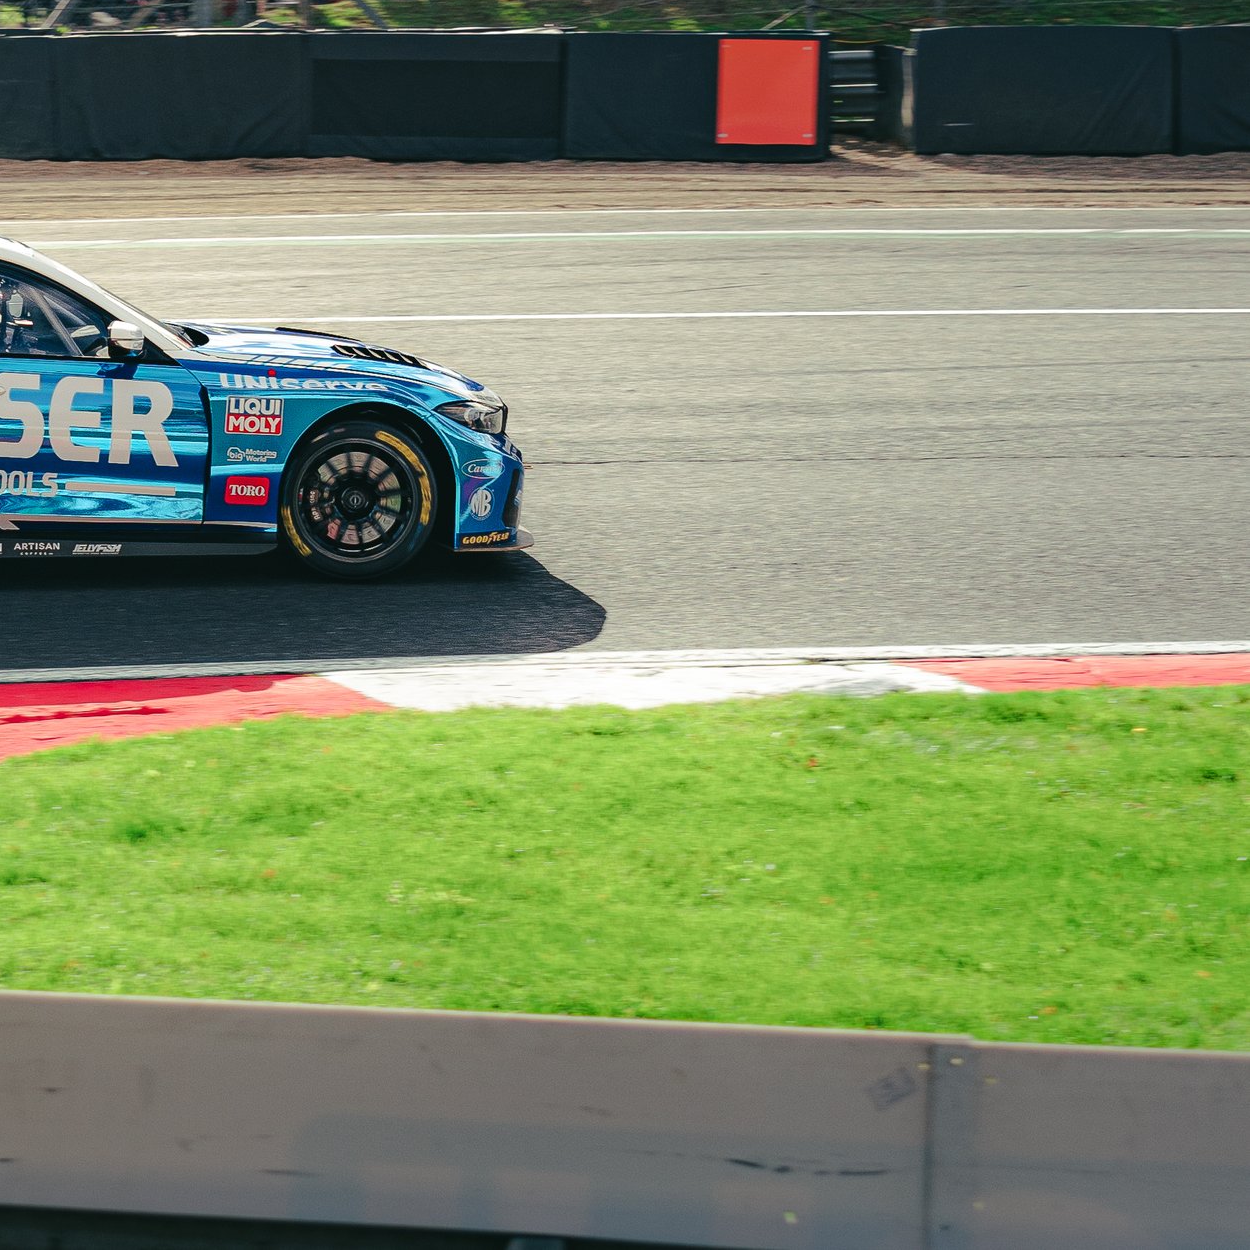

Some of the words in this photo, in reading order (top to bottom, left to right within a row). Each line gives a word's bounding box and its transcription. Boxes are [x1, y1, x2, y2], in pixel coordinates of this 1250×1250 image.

[229, 397, 281, 416] LIQUI
[228, 415, 280, 433] MOLY
[245, 448, 277, 458] Motoring
[229, 484, 265, 497] TORO
[462, 531, 510, 545] GOODYEAR
[13, 542, 60, 551] ARTISAN
